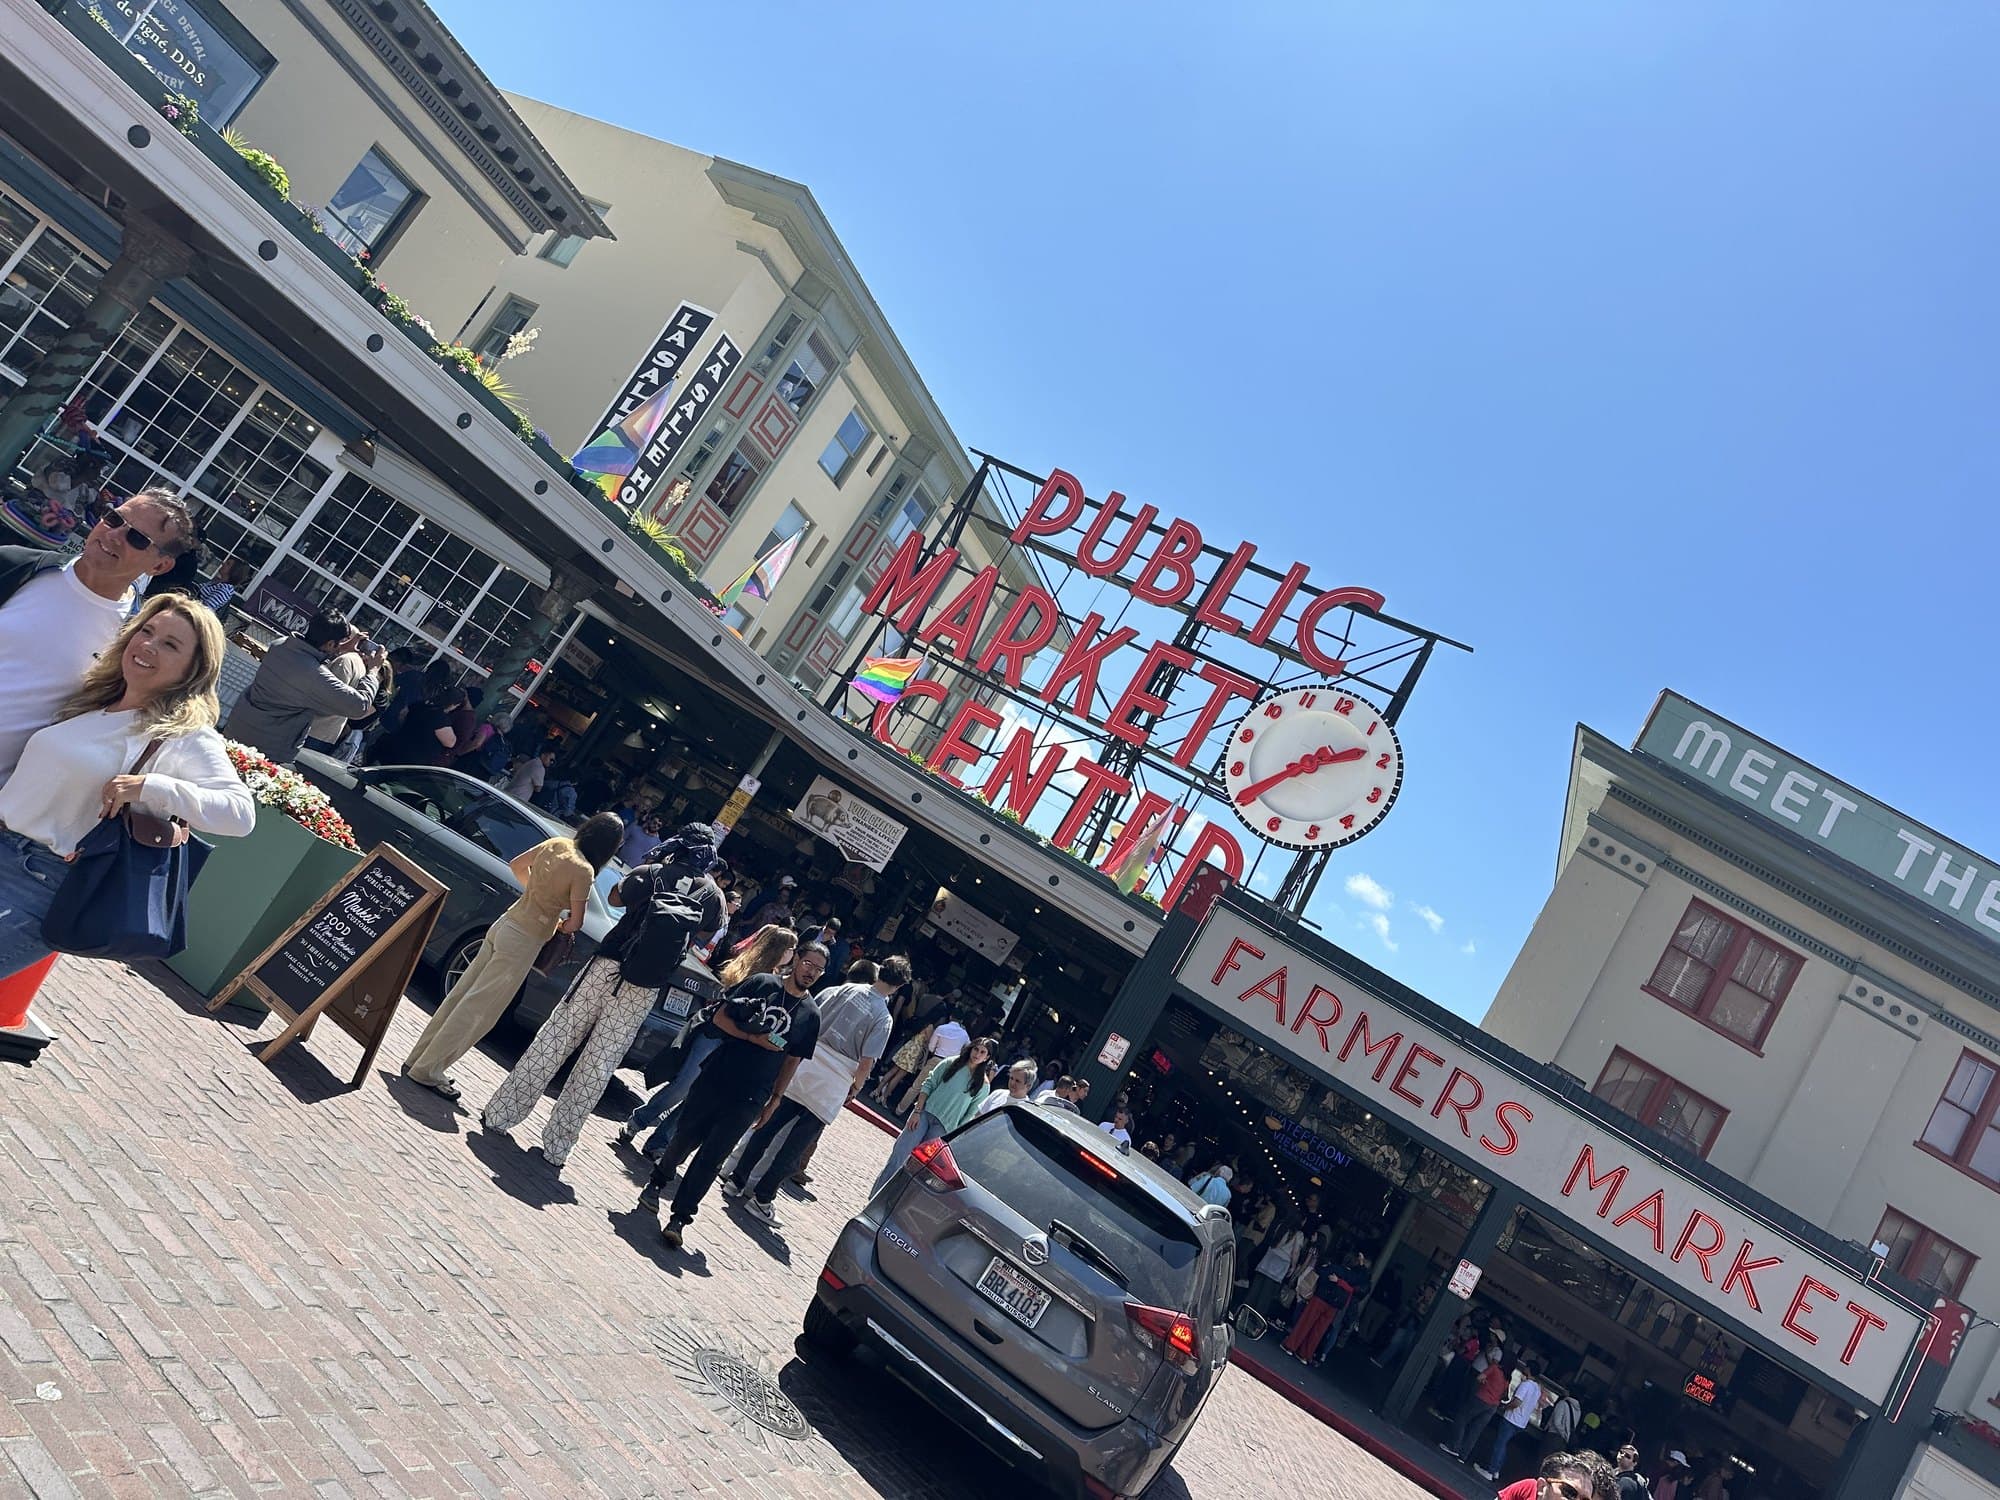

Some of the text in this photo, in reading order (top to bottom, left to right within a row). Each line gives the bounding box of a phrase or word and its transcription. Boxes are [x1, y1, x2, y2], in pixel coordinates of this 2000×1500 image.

[116, 0, 134, 17] de
[169, 48, 206, 87] D.D.S.
[177, 15, 207, 61] DENTAL
[664, 312, 698, 349] LA
[706, 341, 732, 384] LA
[646, 382, 710, 468] SALLE
[1010, 467, 1386, 677] PUBLIC
[860, 529, 1261, 770] MARKET
[1264, 703, 1282, 720] 10
[1299, 692, 1316, 708] 11
[1333, 697, 1354, 716] 12
[1239, 728, 1255, 744] 9
[1366, 721, 1378, 737] 1
[1230, 761, 1245, 777] 8
[1376, 753, 1391, 770] 2
[1672, 720, 1859, 839] MEET
[1366, 787, 1382, 804] 3
[848, 800, 871, 820] YOUR
[1339, 813, 1355, 830] 4
[1267, 816, 1282, 832] 6
[1304, 824, 1321, 840] 5
[364, 874, 407, 907] PUBLIC SEATING
[340, 891, 381, 924] Market
[323, 911, 351, 936] FOOD
[346, 913, 377, 938] CUSTOMERS
[1210, 936, 1534, 1156] FARMERS
[883, 1226, 919, 1259] ROGUE
[1560, 1143, 1888, 1366] MARKET
[1005, 1304, 1033, 1327] NISSAN
[1087, 1385, 1123, 1414] SL AWD
[1685, 1382, 1717, 1404] GROCERY
